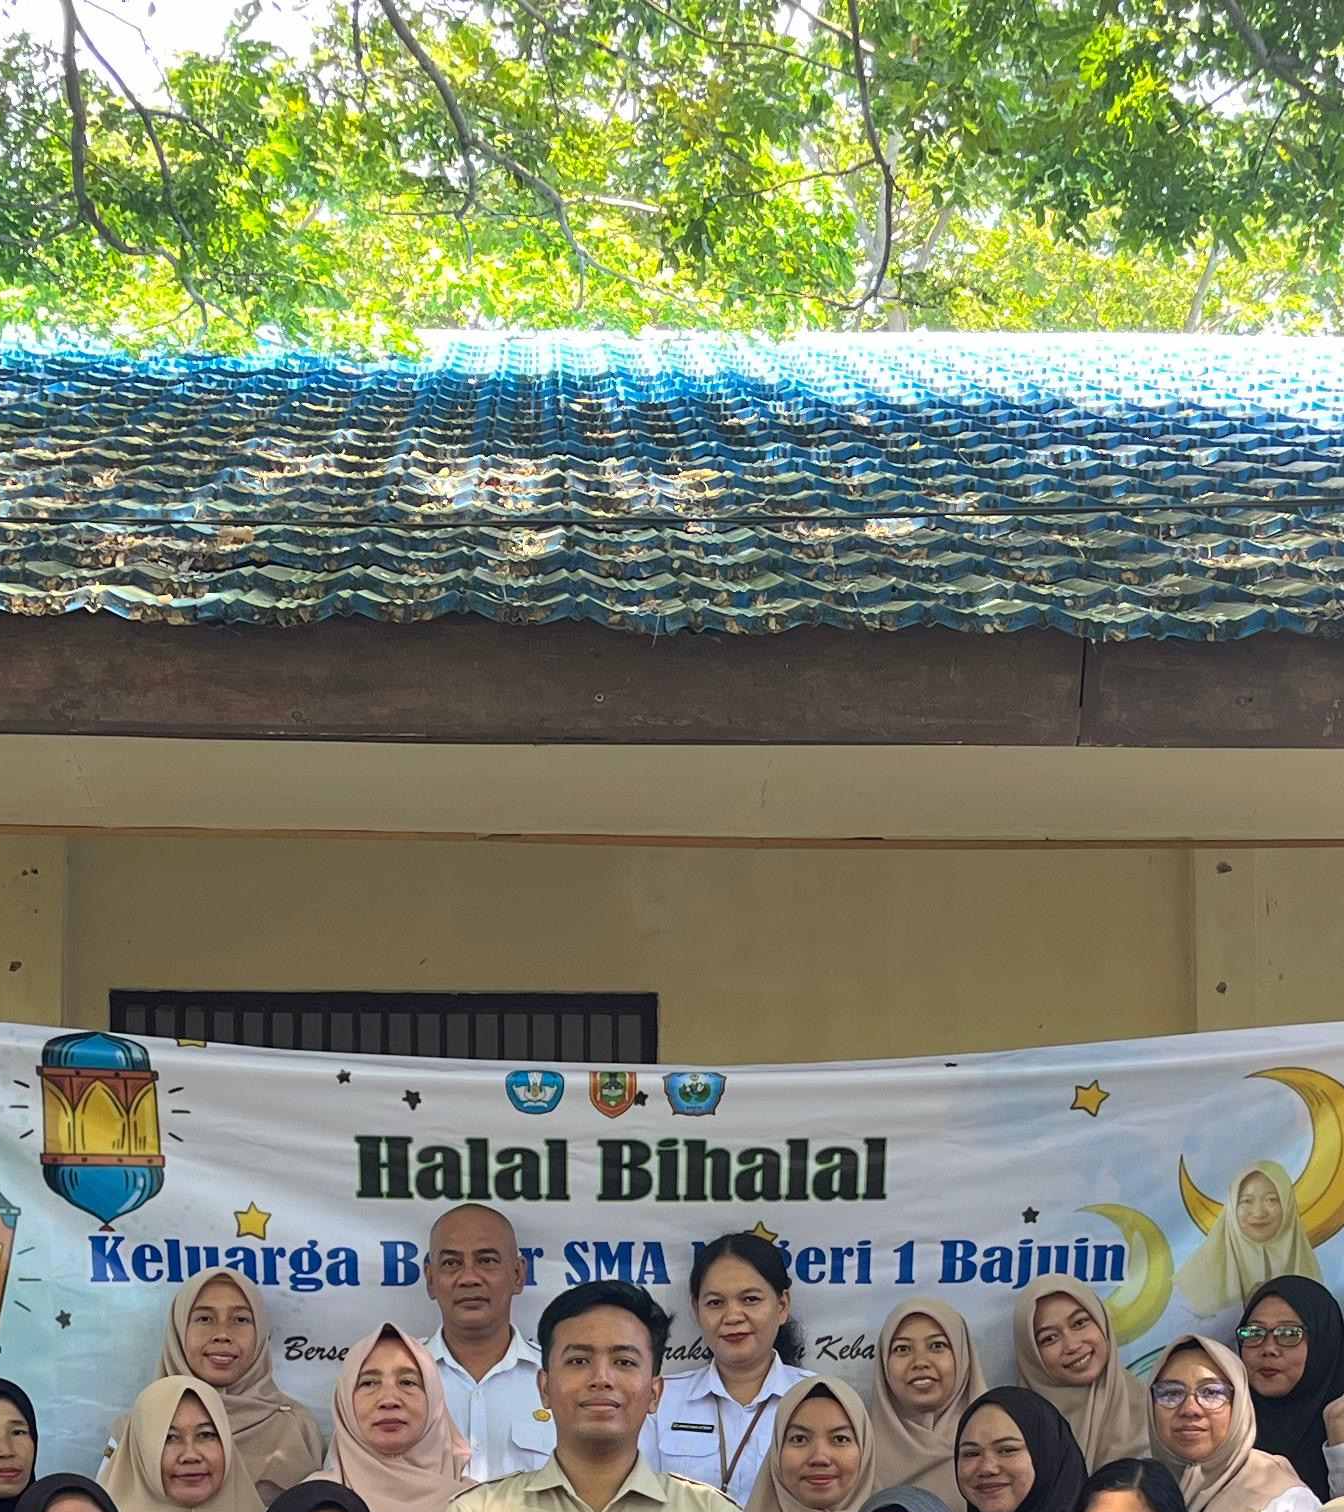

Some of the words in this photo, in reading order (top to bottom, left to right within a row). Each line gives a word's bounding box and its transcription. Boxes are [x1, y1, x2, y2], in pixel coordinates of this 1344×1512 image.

[354, 1135, 571, 1201] Halal
[596, 1137, 887, 1202] Bihalal
[563, 1240, 672, 1286] SMA
[892, 1239, 915, 1285] 1
[938, 1237, 1126, 1290] Bajuin
[283, 1335, 351, 1361] Berse
[814, 1333, 876, 1361] Keba
